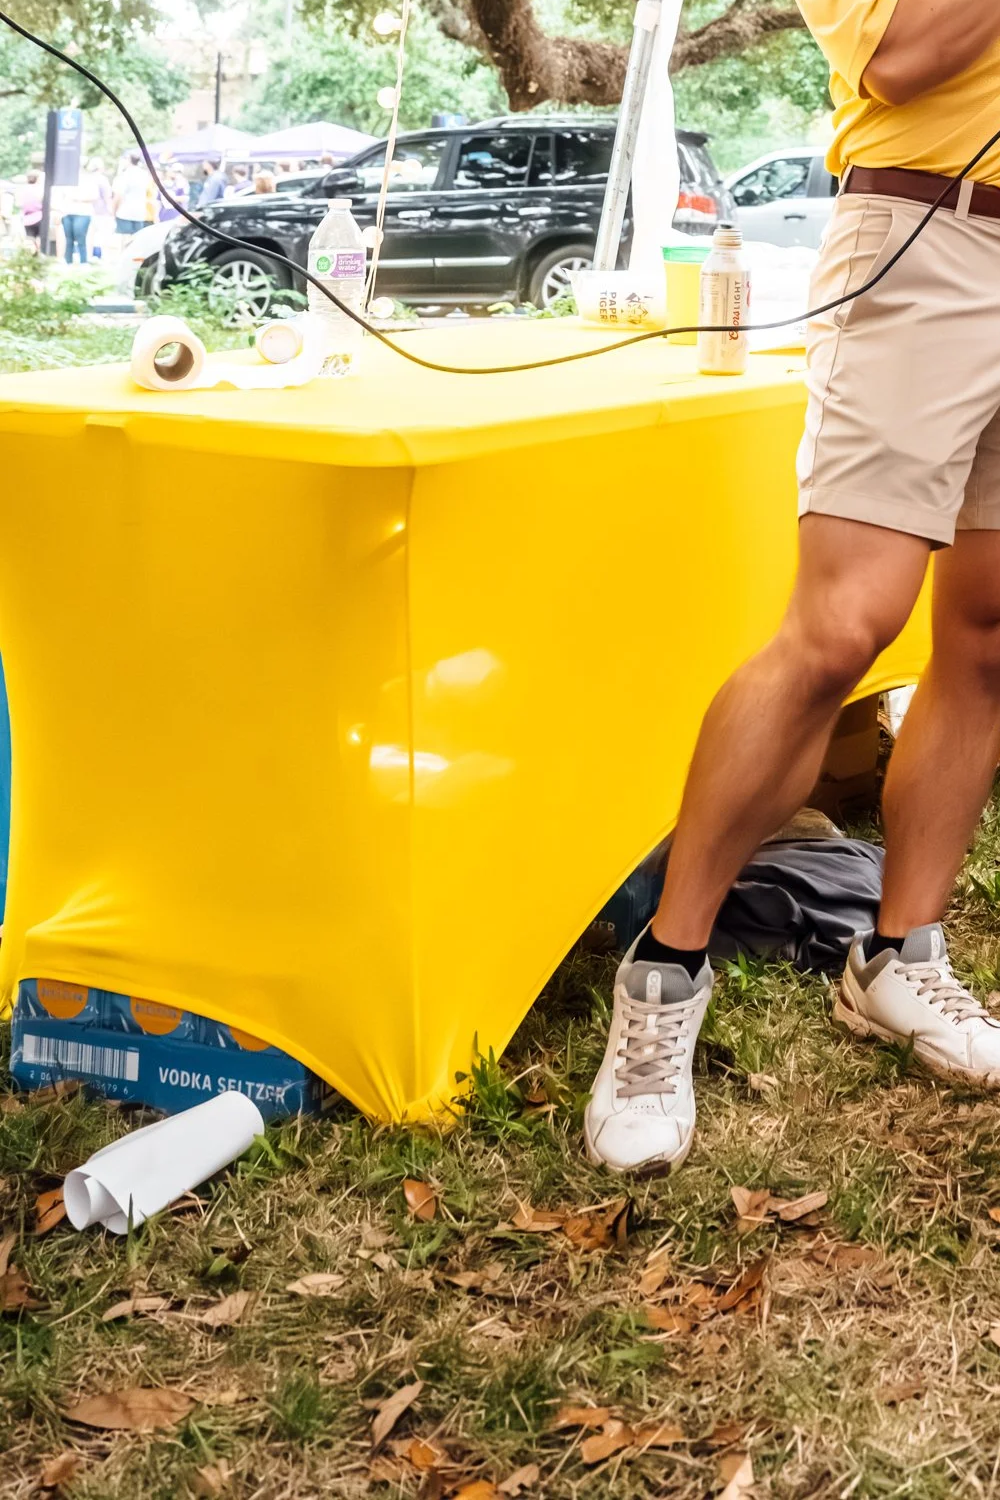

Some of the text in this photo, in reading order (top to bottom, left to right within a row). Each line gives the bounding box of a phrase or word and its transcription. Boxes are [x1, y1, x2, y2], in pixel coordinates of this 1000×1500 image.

[728, 310, 740, 341] Cors
[158, 1067, 285, 1101] VODKA SELTZER
